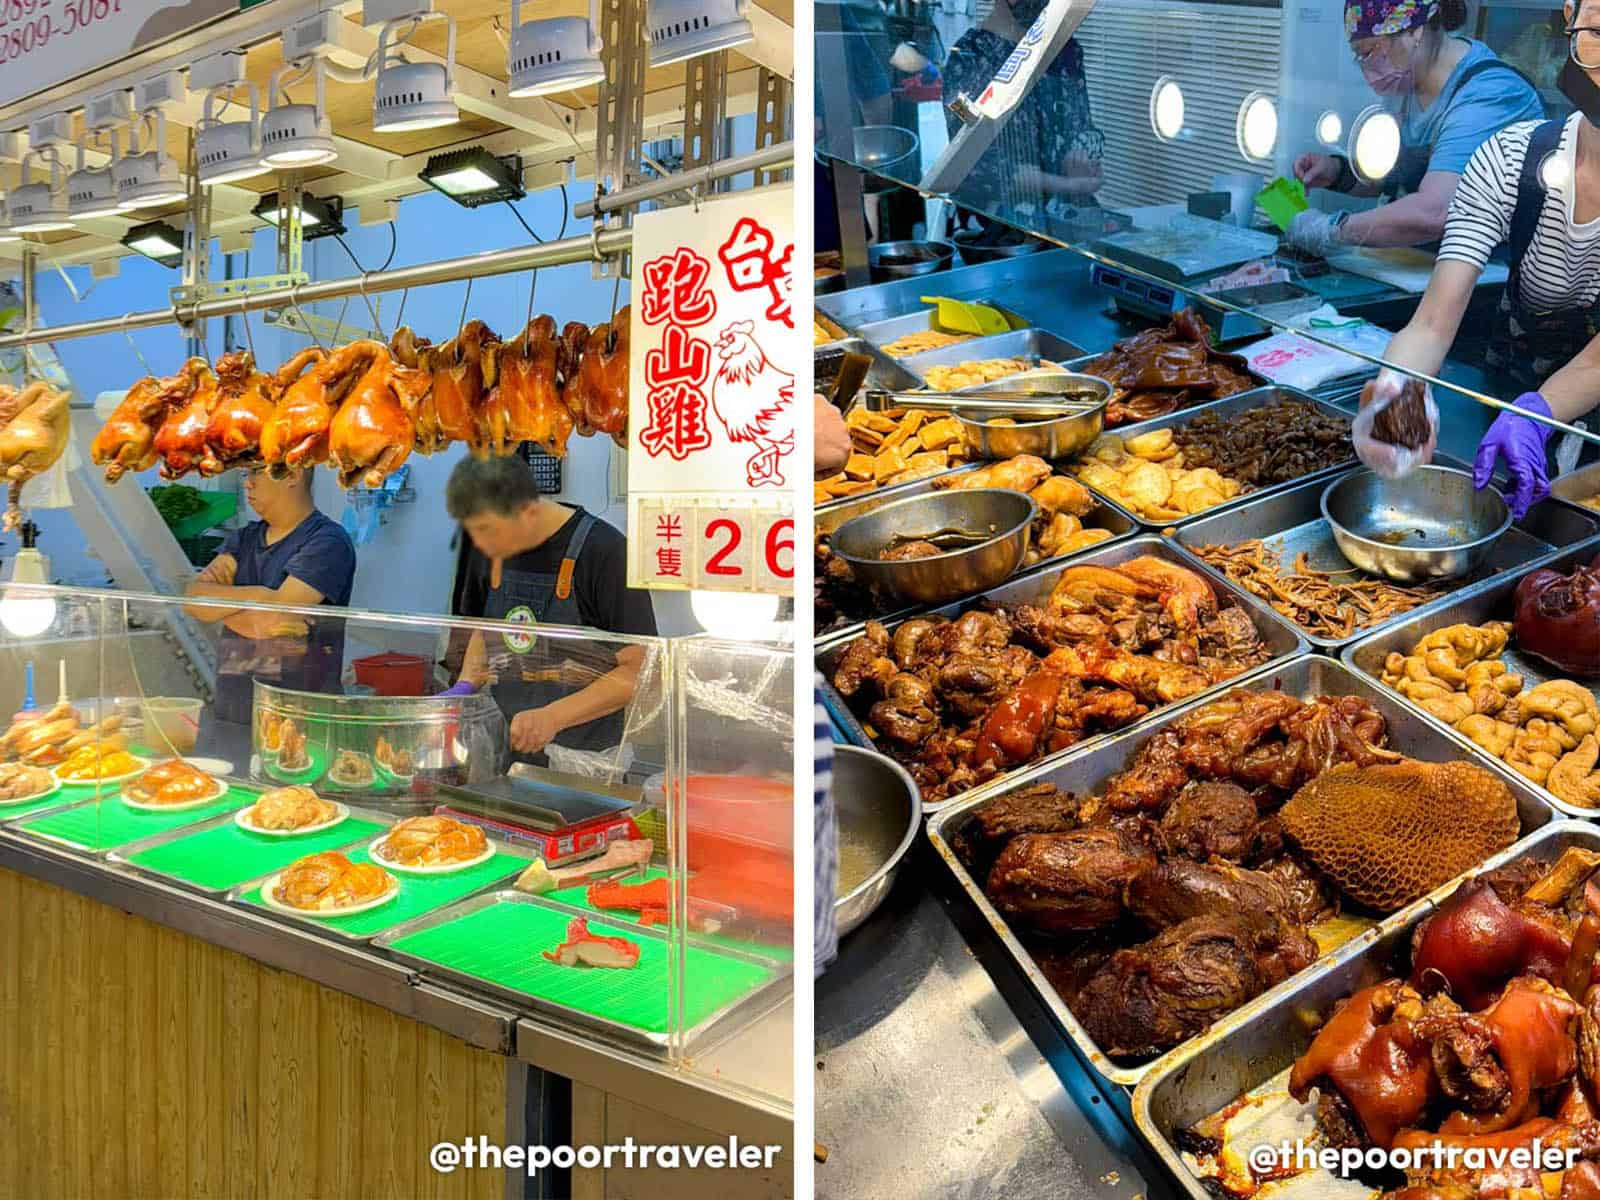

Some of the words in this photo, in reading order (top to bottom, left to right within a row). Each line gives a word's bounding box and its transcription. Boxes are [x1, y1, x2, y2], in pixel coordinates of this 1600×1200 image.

[640, 247, 717, 461] 跑山雞
[656, 514, 682, 576] 半隻
